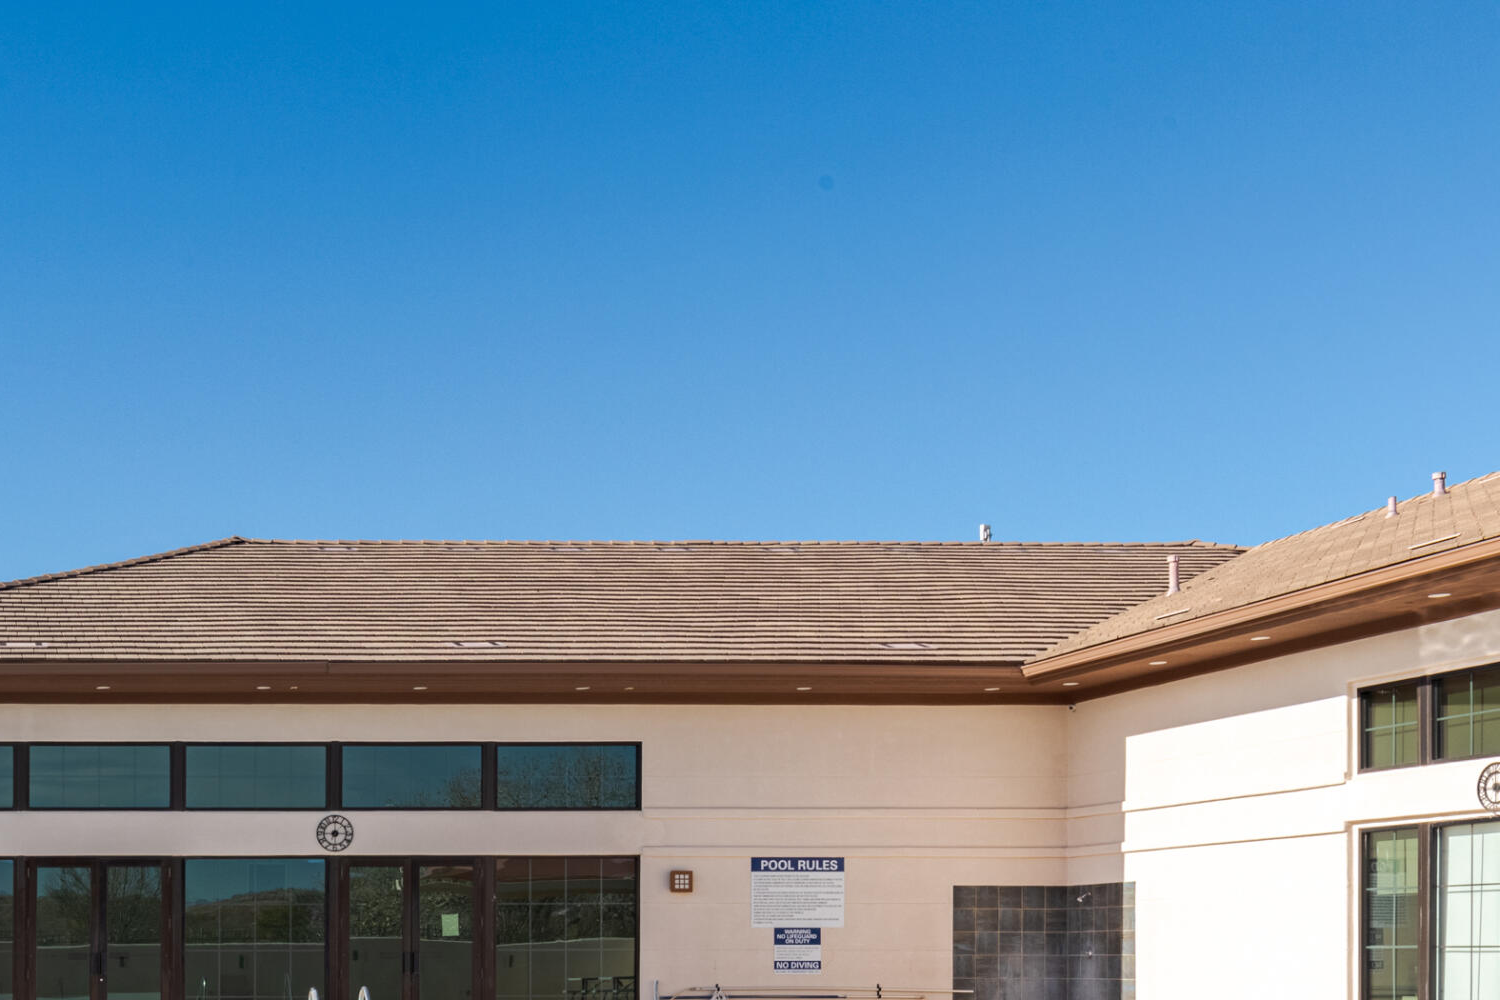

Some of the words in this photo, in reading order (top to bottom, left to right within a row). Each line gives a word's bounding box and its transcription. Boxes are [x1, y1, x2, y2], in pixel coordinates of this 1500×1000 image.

[760, 859, 795, 871] POOL
[797, 859, 838, 871] RULES
[776, 961, 789, 969] NO
[790, 961, 819, 969] DIVING
